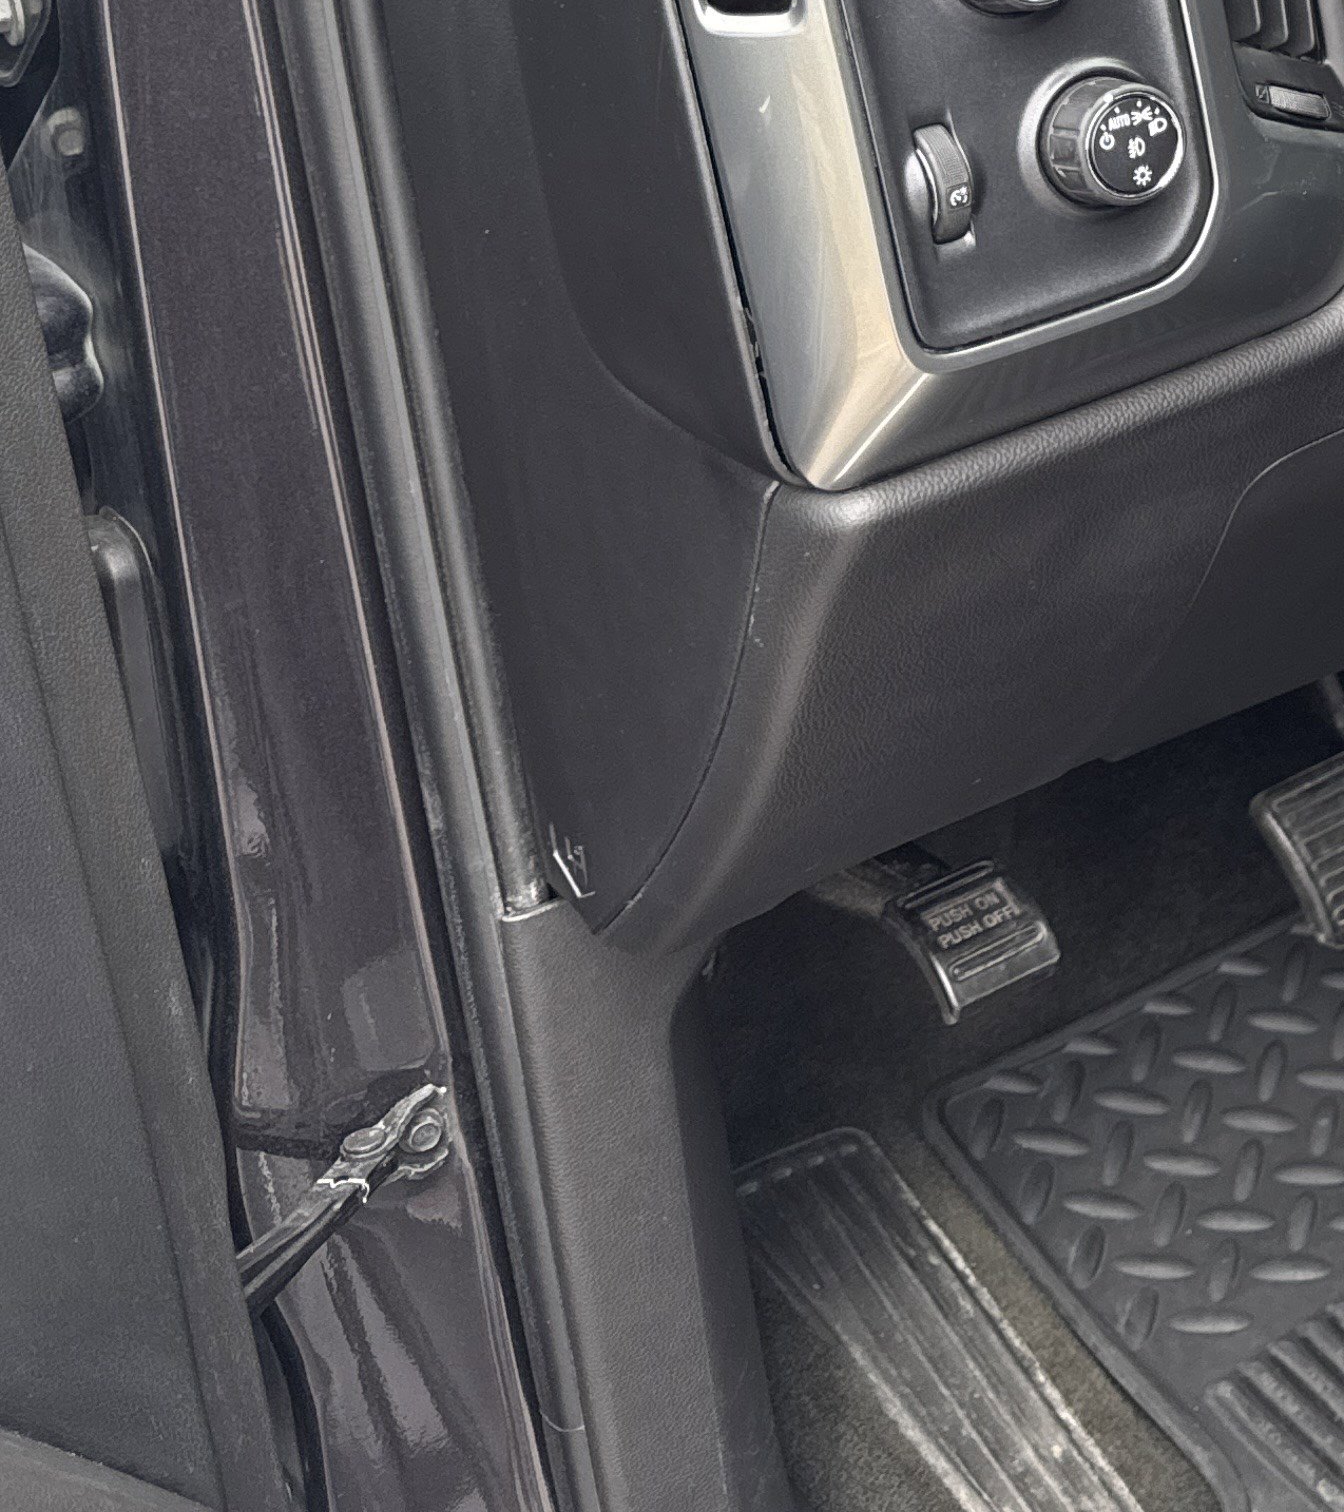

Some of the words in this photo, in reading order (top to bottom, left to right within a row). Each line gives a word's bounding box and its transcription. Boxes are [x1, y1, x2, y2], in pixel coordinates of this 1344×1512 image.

[1108, 113, 1131, 131] AUTO
[928, 902, 974, 932] PUSH
[974, 892, 1001, 911] ON
[937, 921, 983, 949] PUSH
[982, 906, 1014, 929] OFF
